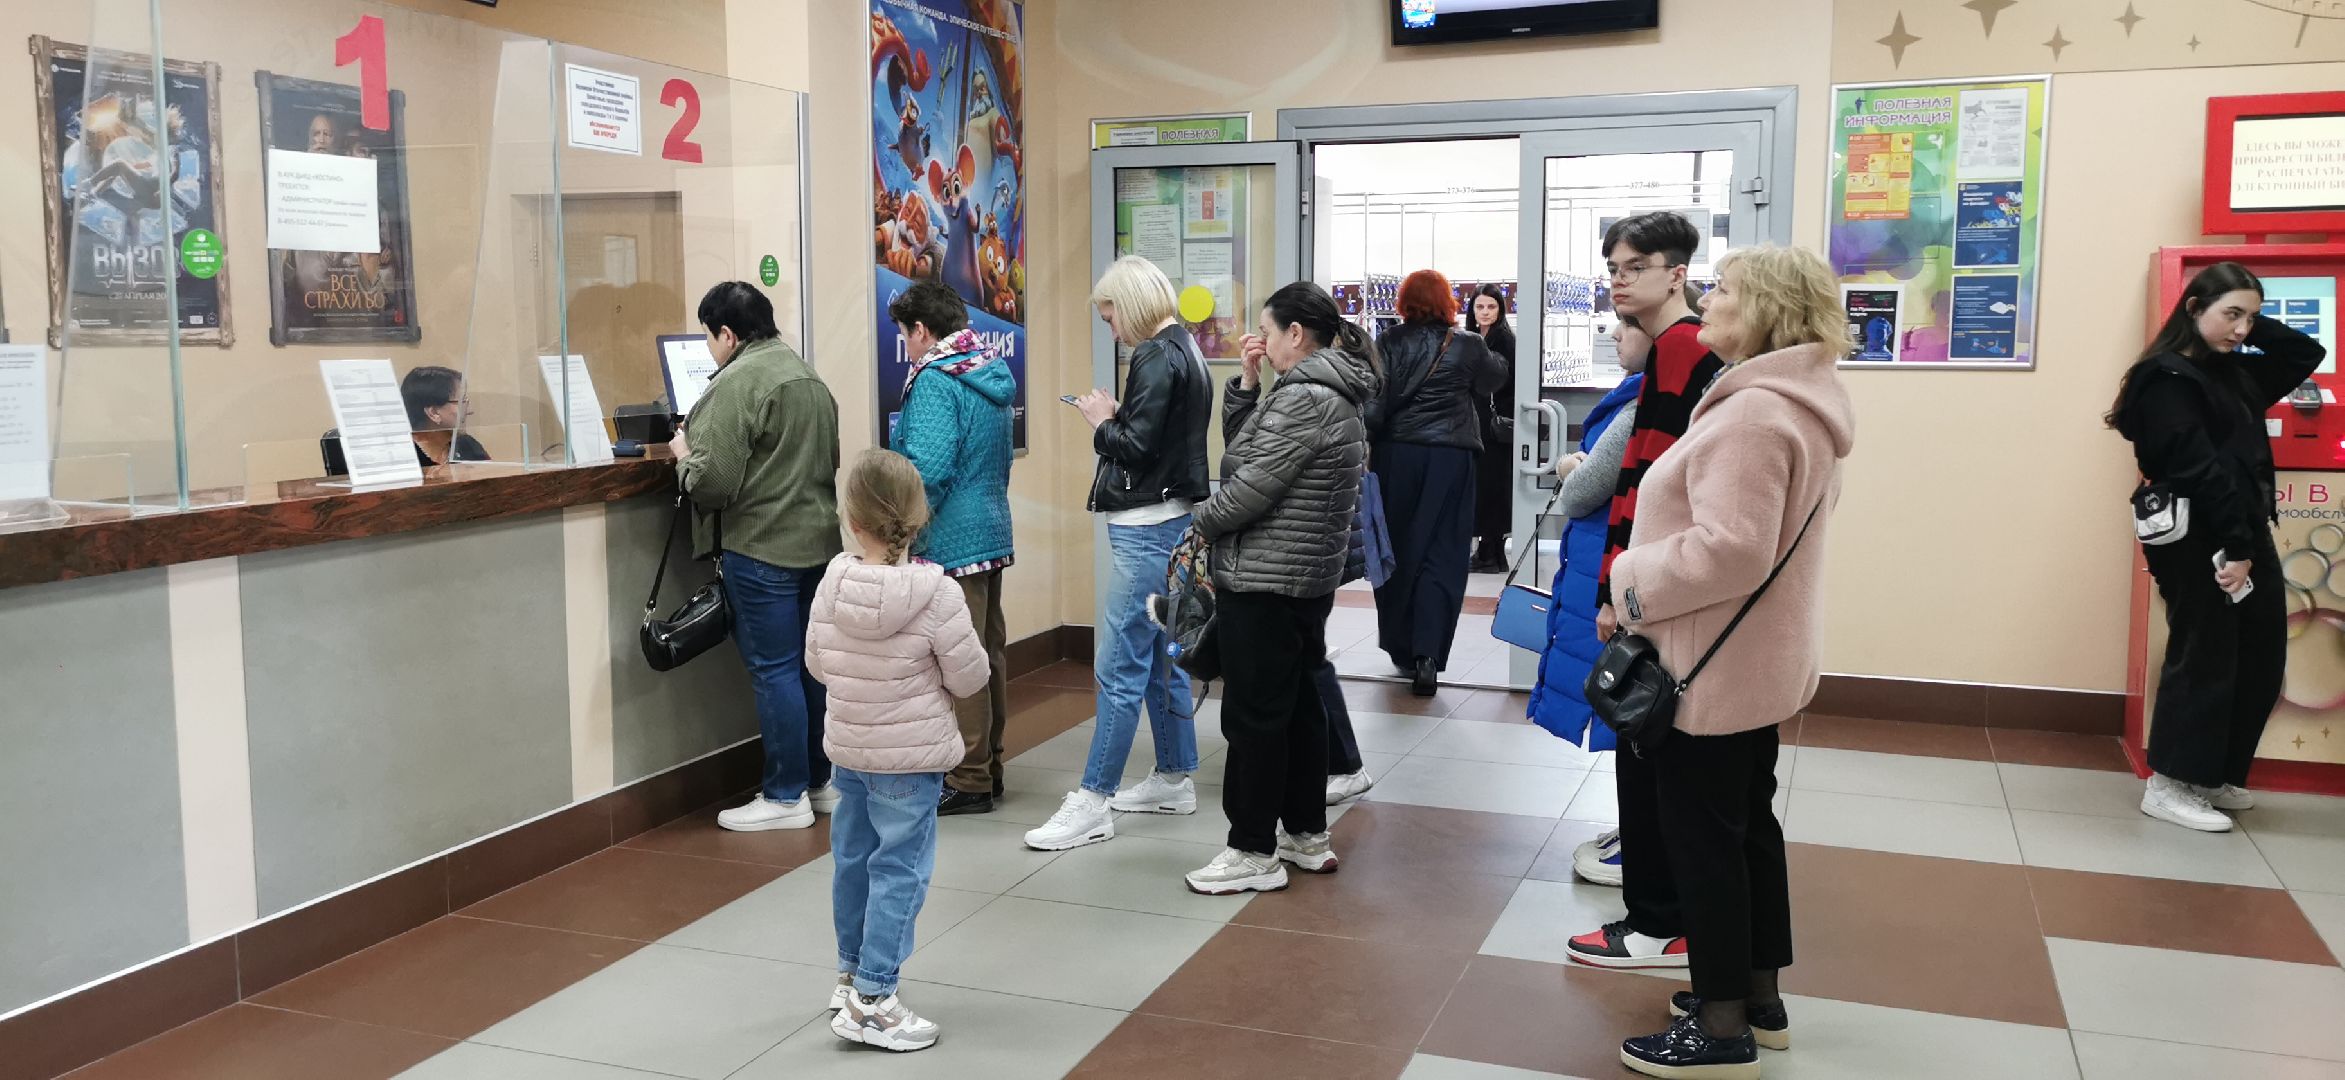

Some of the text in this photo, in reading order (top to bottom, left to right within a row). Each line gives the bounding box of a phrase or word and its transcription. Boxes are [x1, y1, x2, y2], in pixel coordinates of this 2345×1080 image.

[881, 0, 918, 13] ОБЫЧНАЯ
[335, 15, 390, 131] 1
[1874, 97, 1952, 112] ПОЛЕЗНАЯ
[660, 78, 703, 163] 2
[1845, 111, 1952, 127] ИНФОРМАЦИЯ
[1161, 129, 1219, 141] ПОЛЕЗНАЯ
[2244, 142, 2281, 153] ЗДЕСЬ
[2284, 140, 2303, 150] ВЫ
[2234, 153, 2313, 166] ПРИОБРЕСТИ
[2257, 166, 2344, 178] РАСПЕЧАТАТЬ
[2235, 180, 2326, 192] ЭЛЕКТРОННЫЙ
[330, 274, 358, 291] ВСЕ
[304, 290, 386, 310] СТРАХИ БО
[2275, 484, 2329, 503] Ы В
[2278, 507, 2345, 524] мообсл
